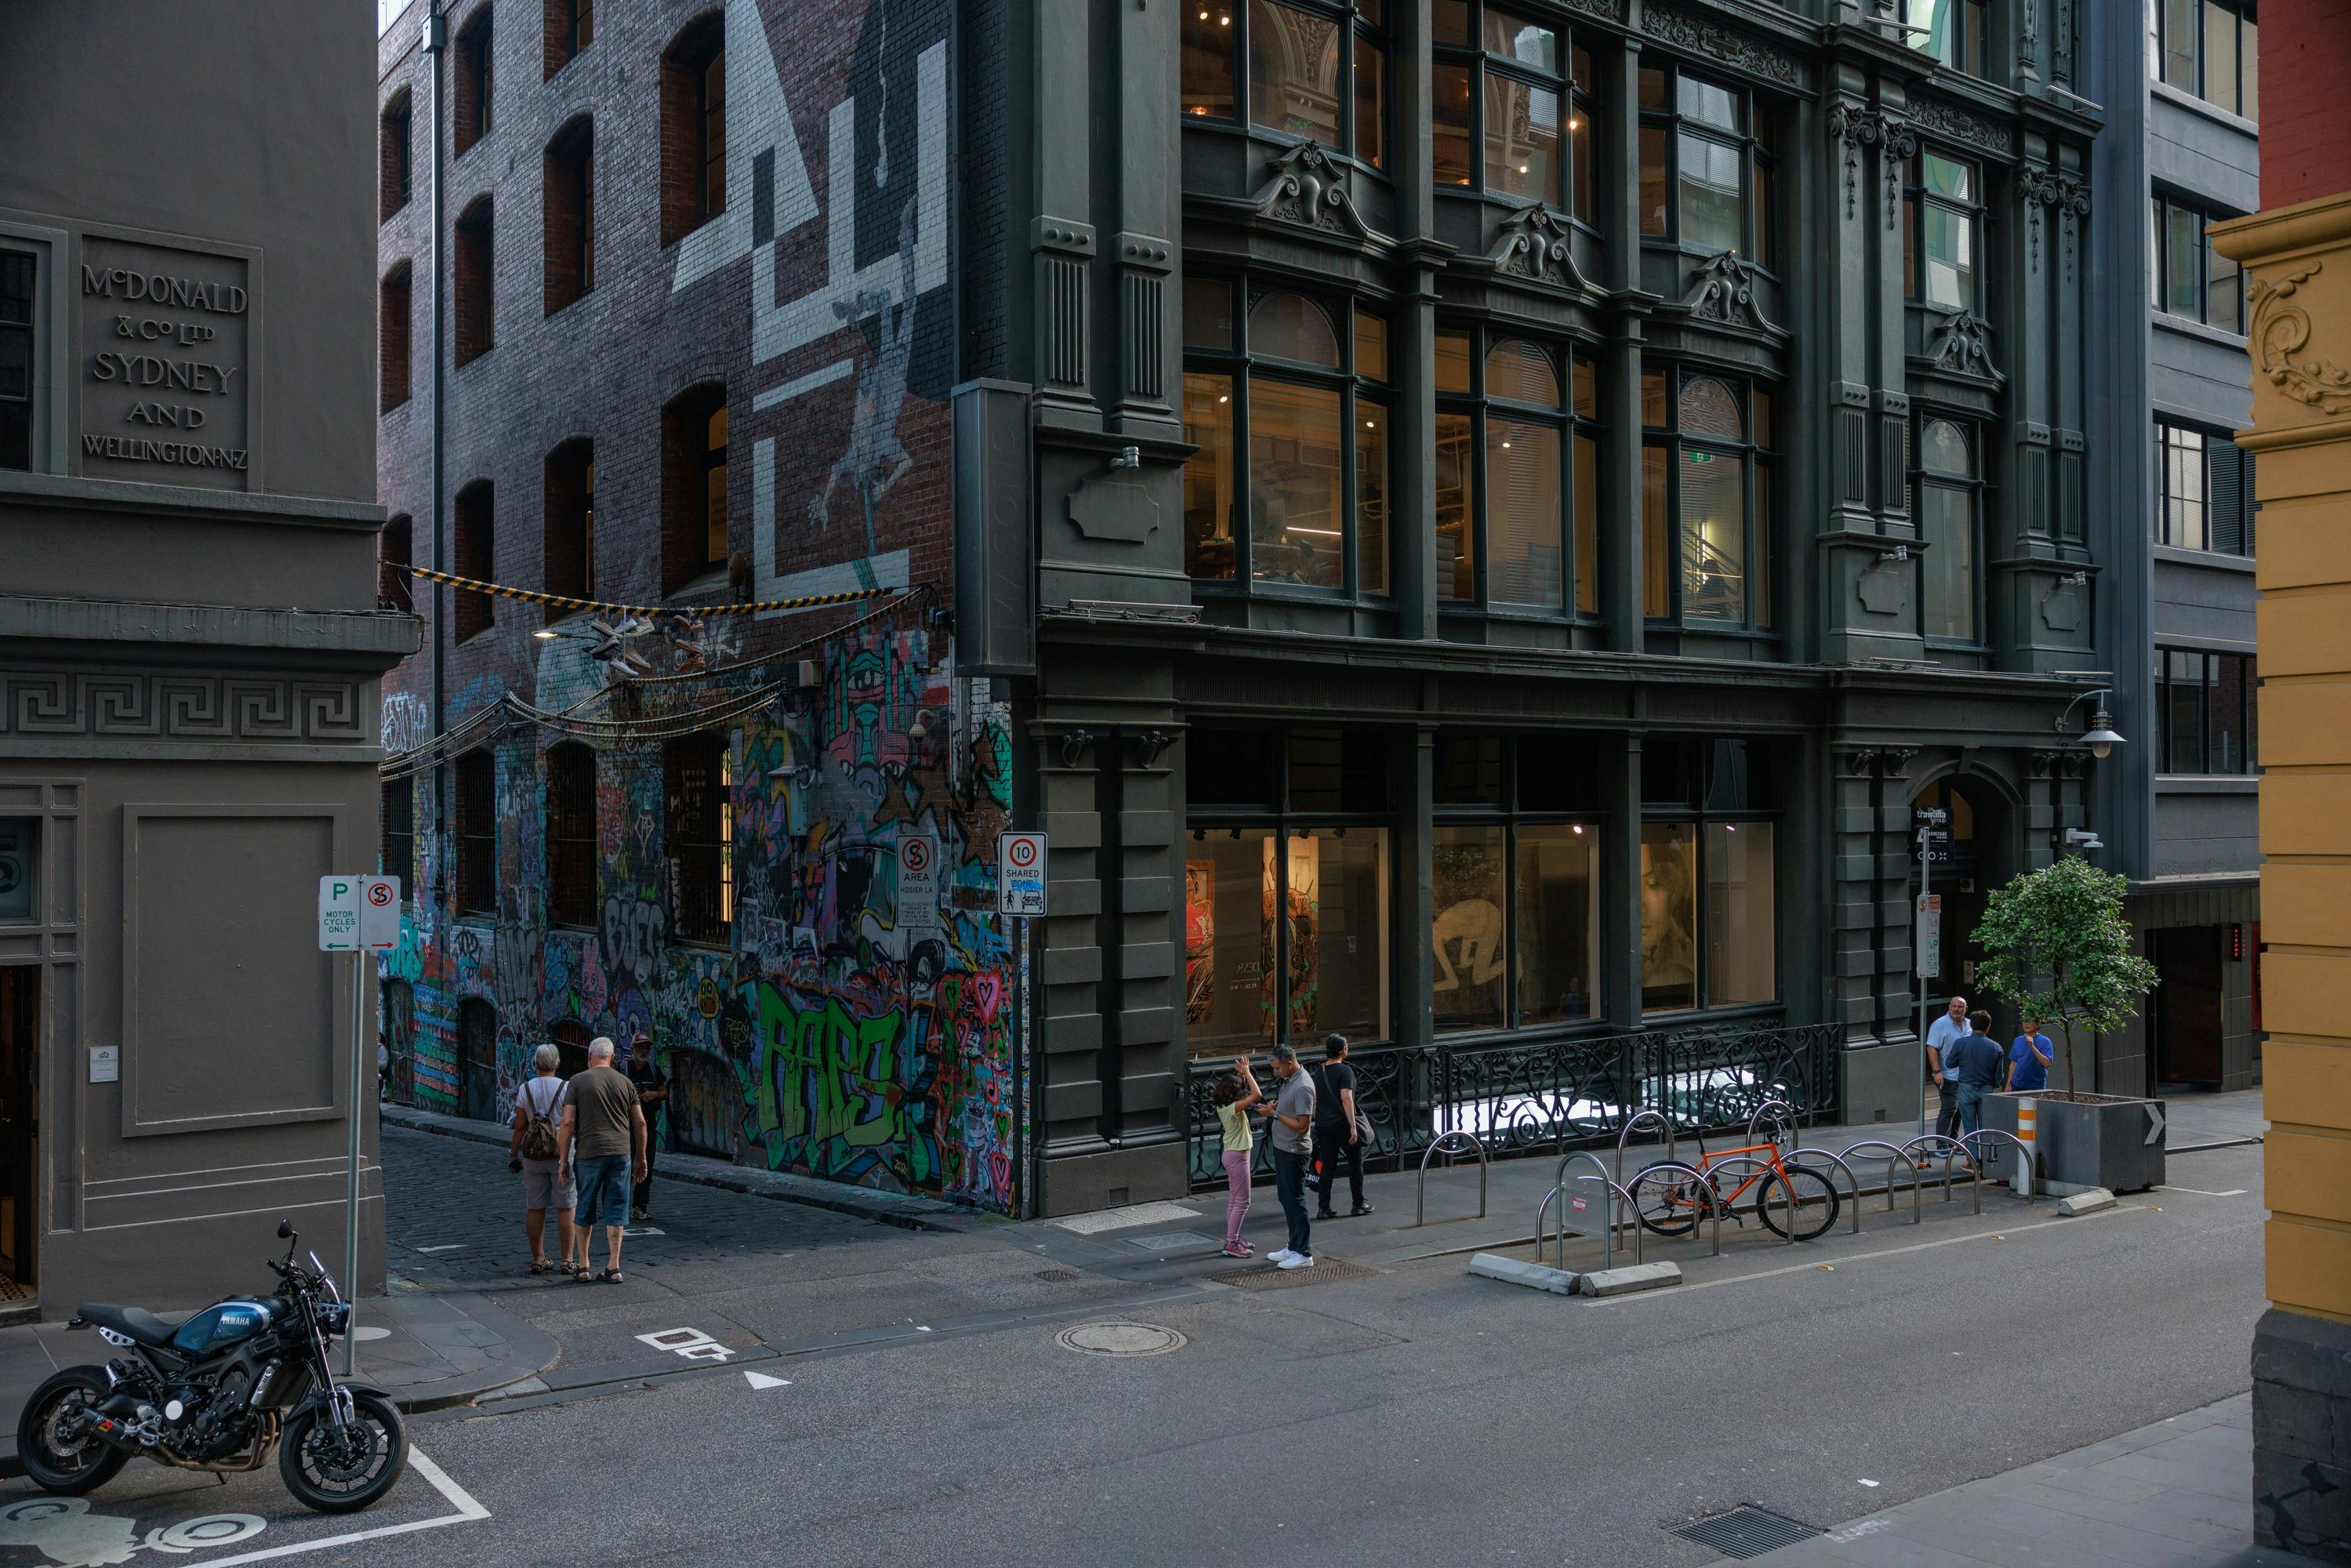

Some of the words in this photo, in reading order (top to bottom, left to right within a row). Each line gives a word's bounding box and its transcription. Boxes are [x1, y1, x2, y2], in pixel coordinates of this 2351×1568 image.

[117, 314, 133, 338] &
[93, 353, 238, 394] SYDNEY
[126, 401, 206, 428] AND
[1017, 847, 1030, 858] 10
[333, 883, 348, 900] P
[221, 1316, 250, 1325] YAMAHA
